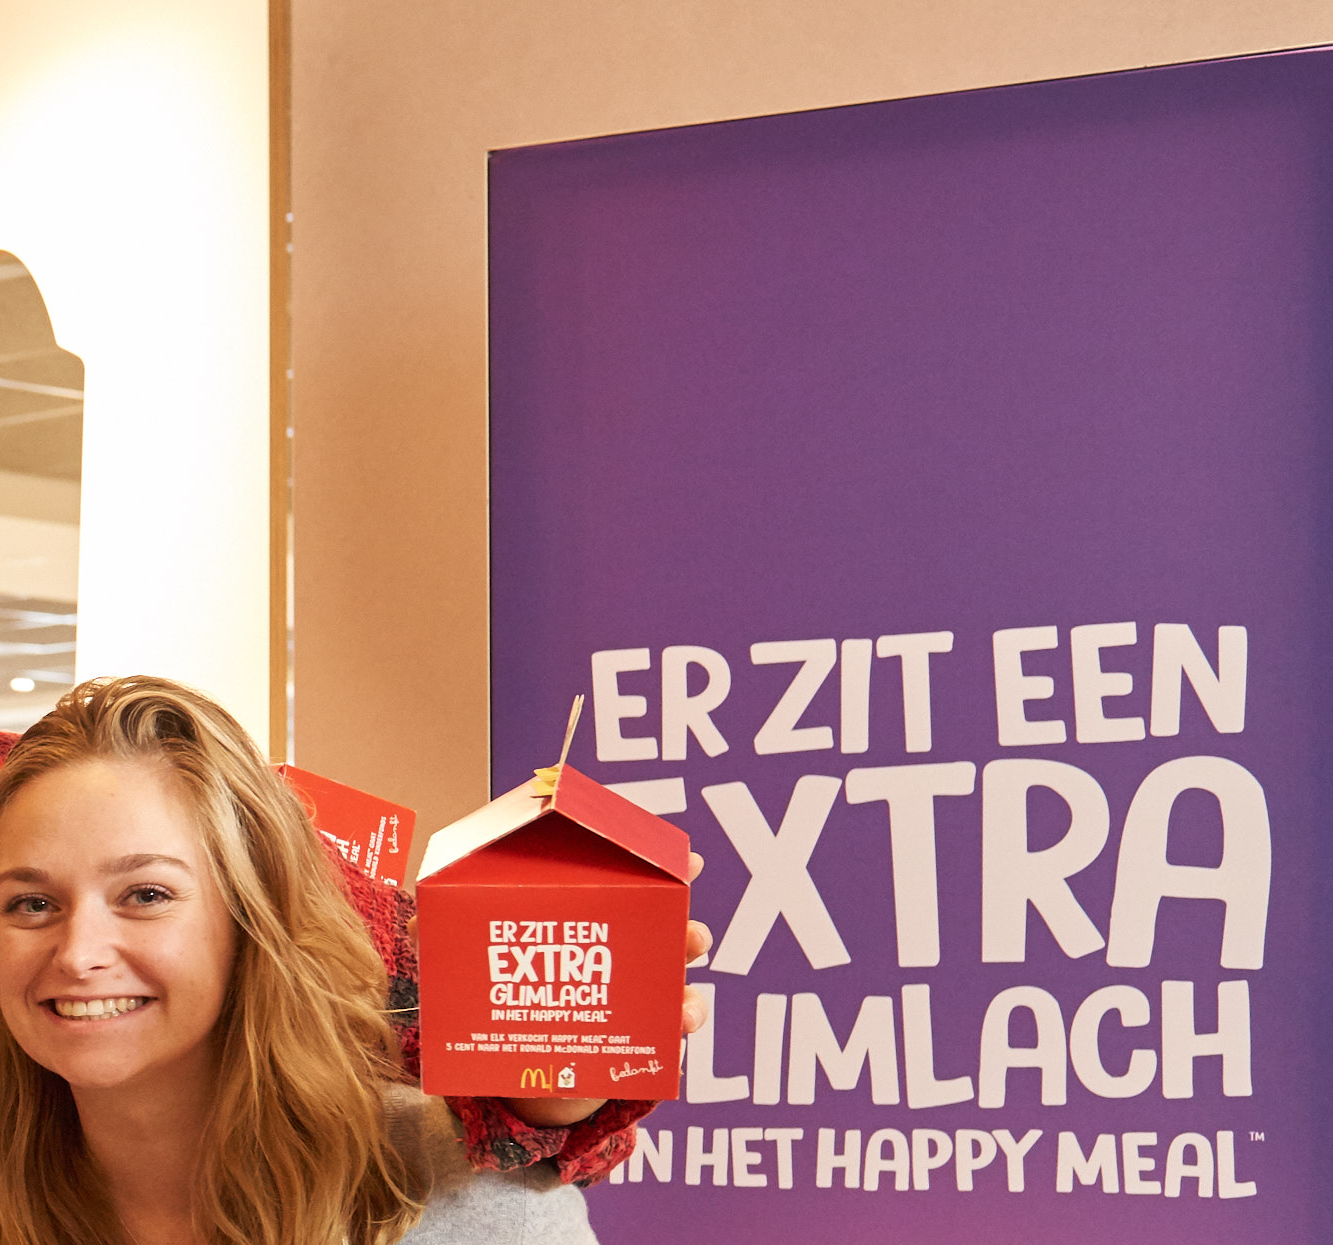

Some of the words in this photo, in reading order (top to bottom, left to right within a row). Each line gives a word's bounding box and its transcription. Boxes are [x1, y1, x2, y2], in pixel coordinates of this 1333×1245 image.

[590, 645, 732, 762] ER
[749, 630, 955, 755] ZIT
[992, 621, 1248, 747] EEN
[489, 920, 518, 943] ER
[519, 920, 558, 944] ZIT
[563, 921, 609, 944] EEN
[487, 944, 612, 984] EXTRA
[489, 983, 608, 1008] GLIMLACH
[491, 1009, 505, 1021] IN
[506, 1009, 529, 1022] HET
[529, 1009, 571, 1022] HAPPY
[454, 1043, 475, 1052] CENT
[477, 1044, 500, 1052] NAAR
[502, 1044, 517, 1052] HET
[520, 1044, 552, 1053] RONALD
[554, 1045, 599, 1054] McDONALD
[601, 1045, 656, 1055] KINDERFONDS
[471, 1033, 488, 1042] VAN
[490, 1033, 505, 1042] ELK
[508, 1034, 549, 1043] VERKOCHT
[551, 1034, 578, 1043] HAPPY
[608, 1035, 631, 1044] GAAT
[679, 979, 1253, 1110] LIMLACH
[684, 1125, 804, 1190] HET
[815, 1127, 1044, 1193] HAPPY
